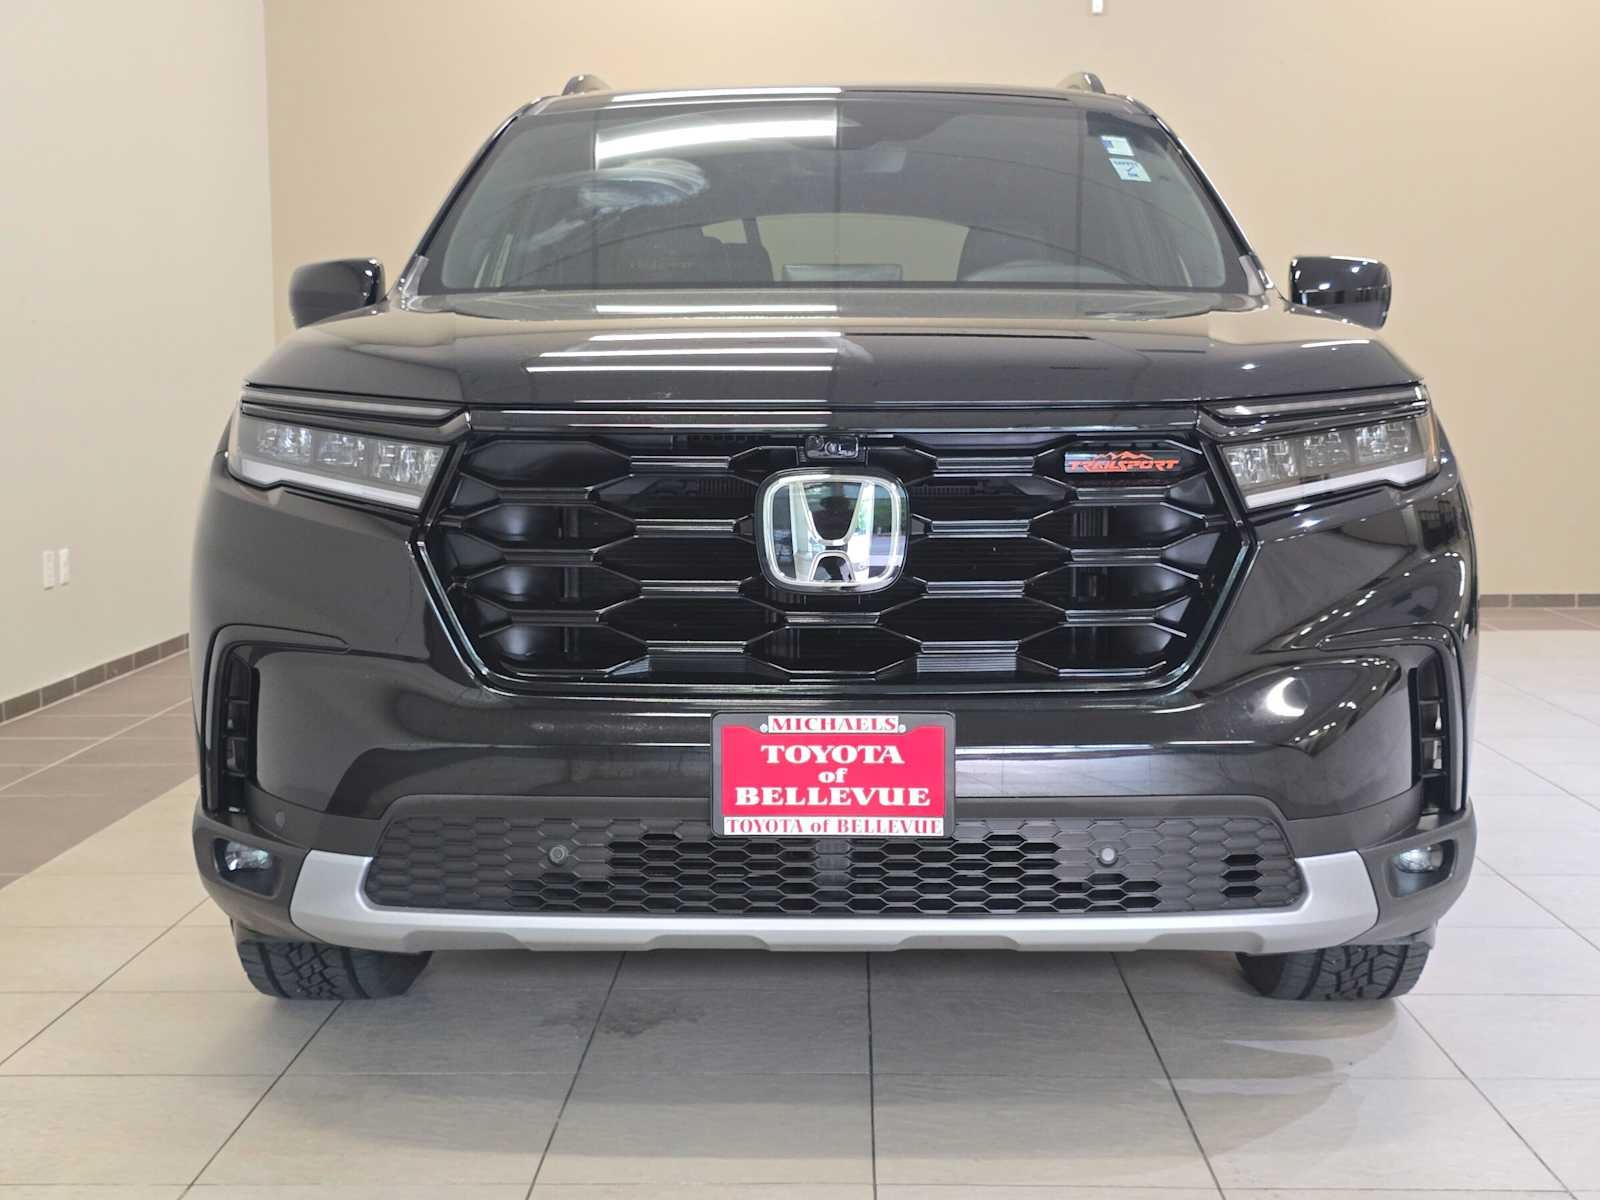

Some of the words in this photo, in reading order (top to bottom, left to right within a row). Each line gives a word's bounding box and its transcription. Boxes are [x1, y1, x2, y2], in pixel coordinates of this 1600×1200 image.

[771, 717, 897, 731] MICHAELS
[761, 744, 905, 764] TOYOTA
[818, 767, 848, 783] of
[735, 787, 931, 806] BELLEVUE
[727, 819, 802, 834] TOYOTA
[810, 818, 829, 833] of
[838, 819, 942, 834] BELLEVUE
